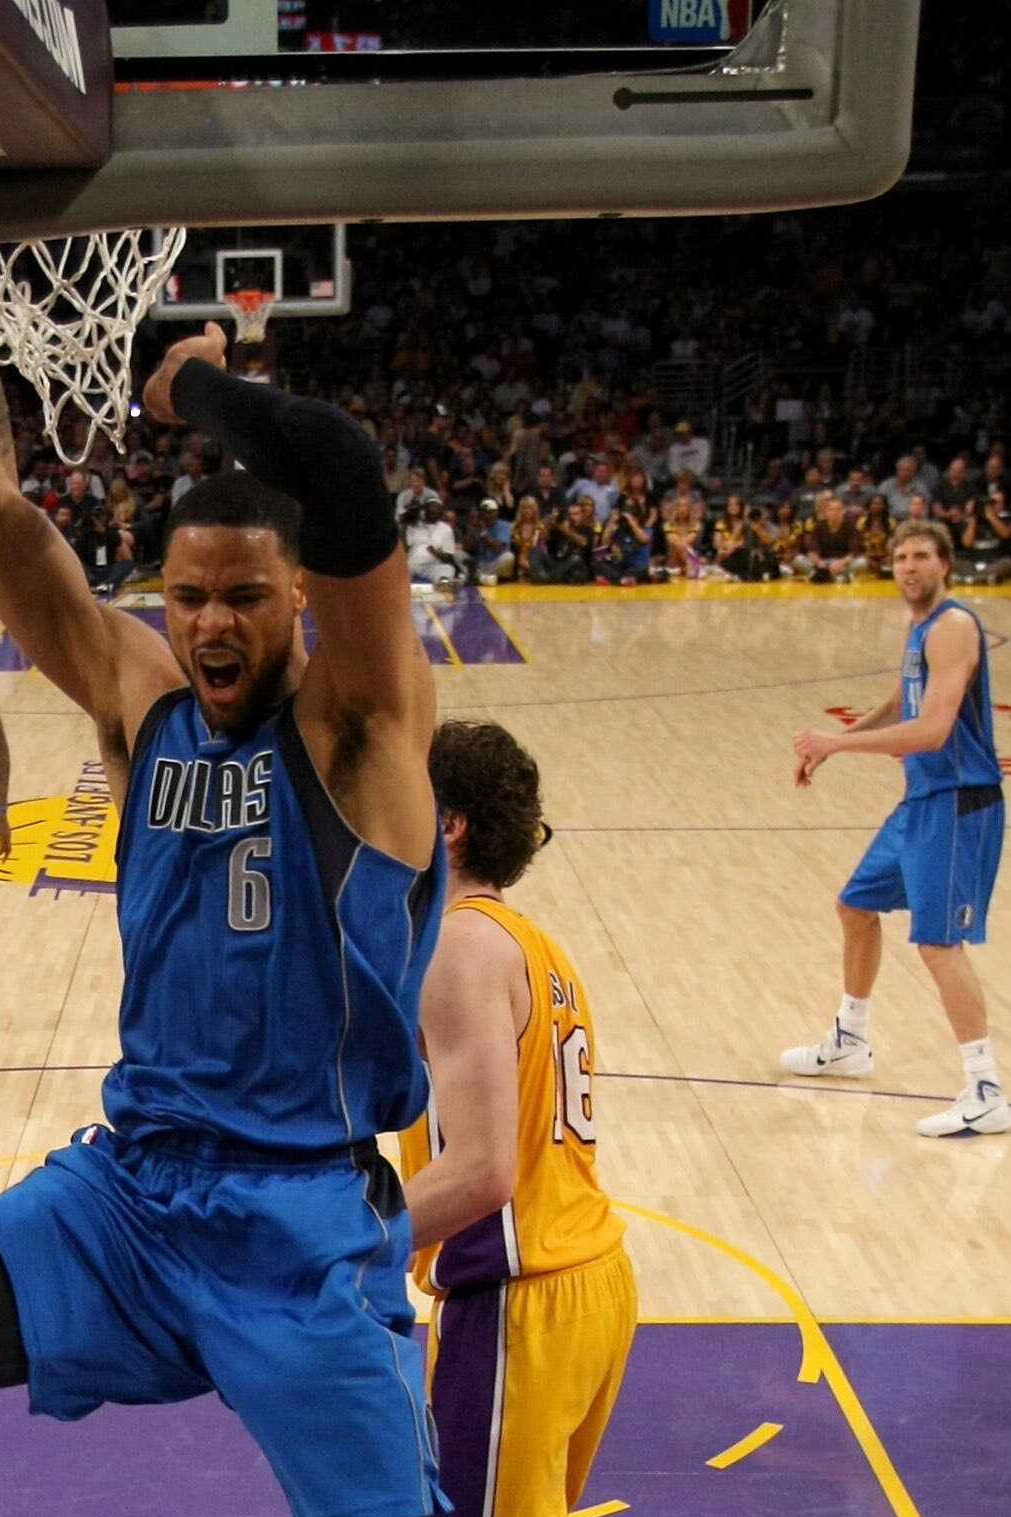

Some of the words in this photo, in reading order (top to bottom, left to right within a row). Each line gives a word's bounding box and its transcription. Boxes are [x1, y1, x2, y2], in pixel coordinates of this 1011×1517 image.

[660, 0, 716, 28] NBA
[44, 831, 101, 863] LOS
[228, 837, 272, 931] 6
